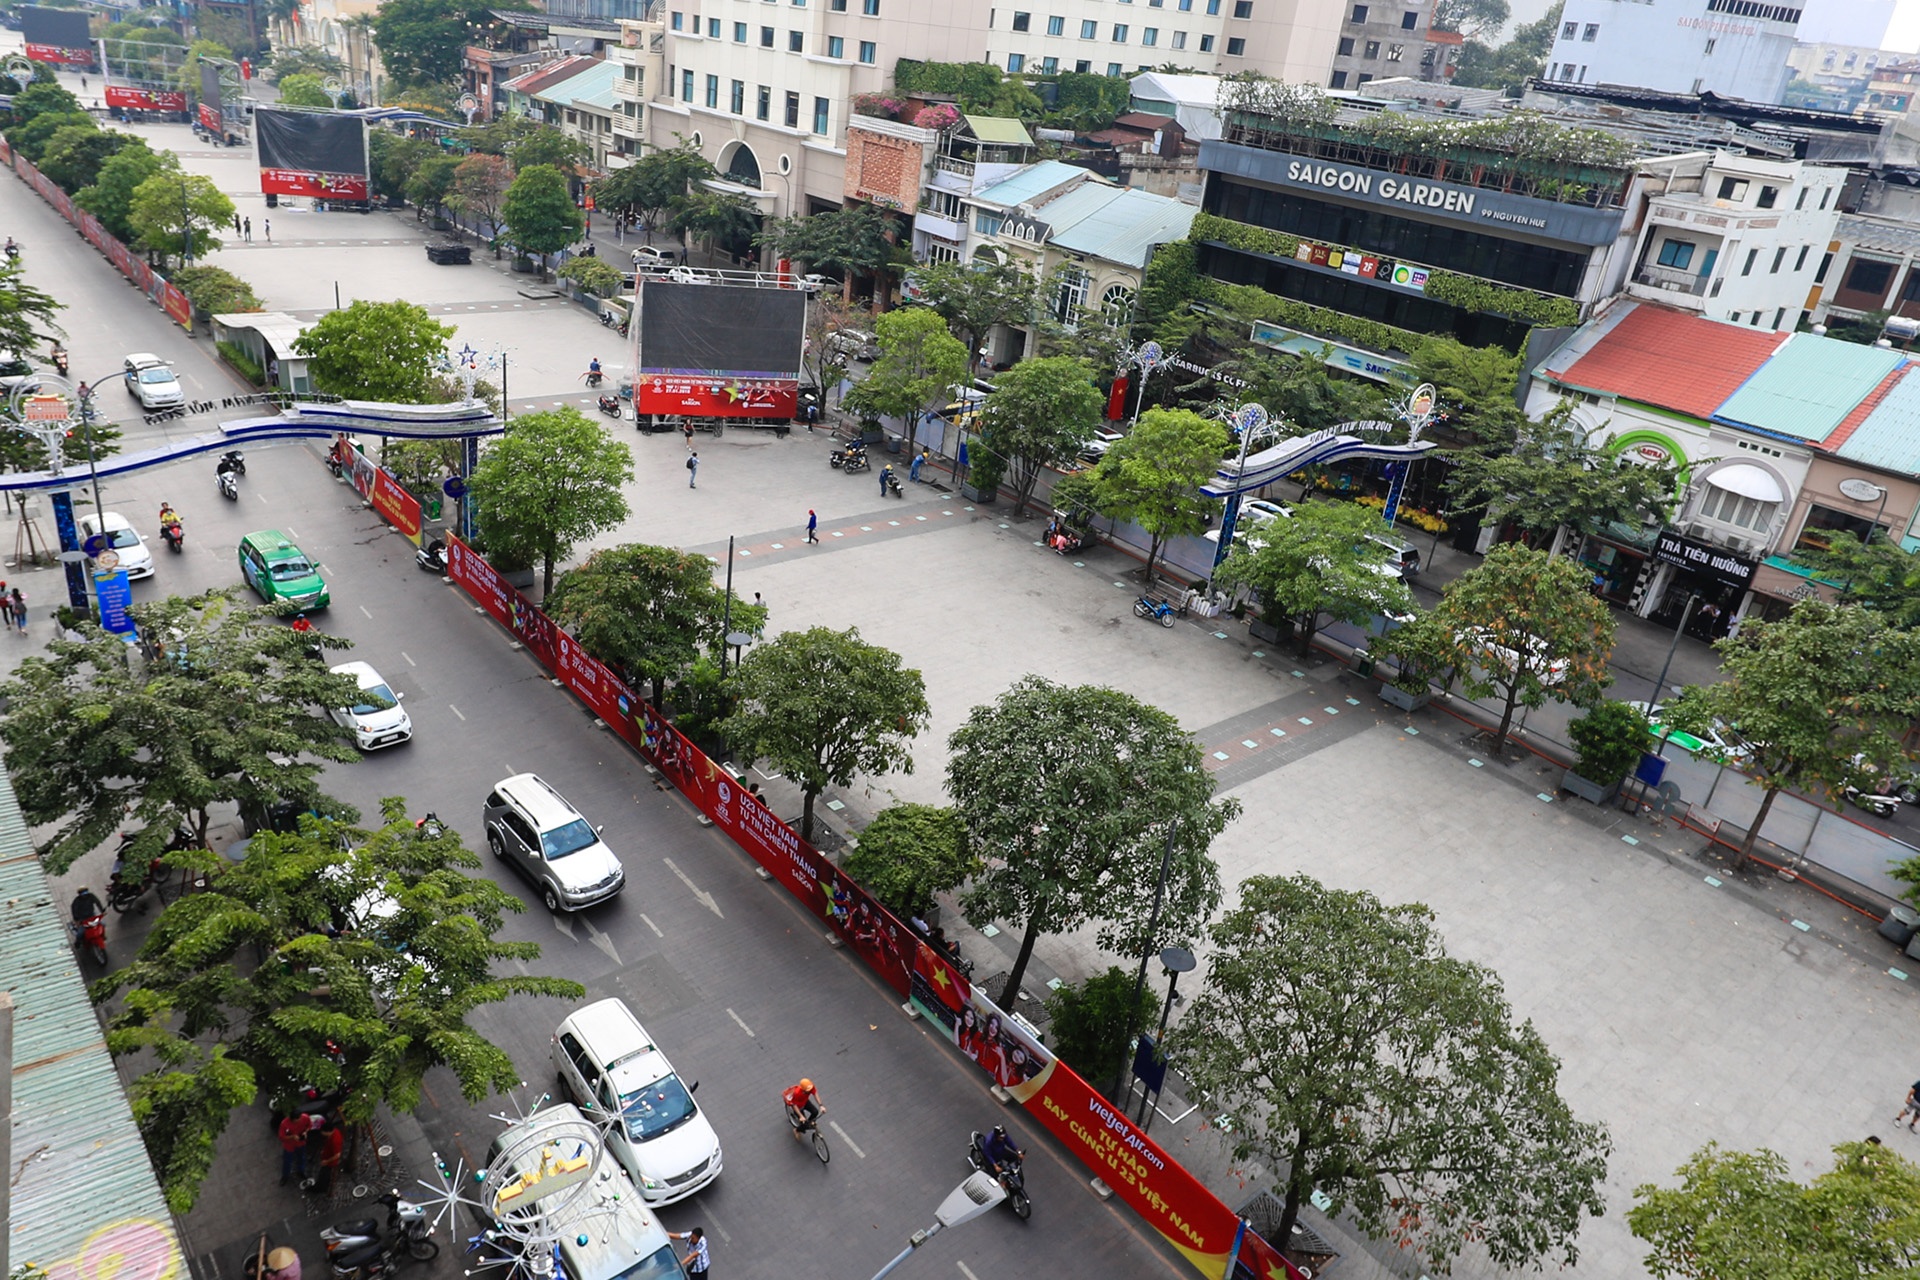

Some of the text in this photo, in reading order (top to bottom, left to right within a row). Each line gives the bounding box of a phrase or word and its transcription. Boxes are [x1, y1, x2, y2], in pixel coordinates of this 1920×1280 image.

[1287, 161, 1546, 229] SAIGON GARDEN 99 NGUYEN HUE
[1363, 262, 1374, 272] 2F
[1310, 420, 1393, 444] HAPPY NEW YEAR 2018
[1660, 538, 1681, 554] TRÀ
[1684, 546, 1710, 564] TIÊN
[740, 793, 756, 813] U23
[778, 826, 799, 851] NAM
[750, 815, 763, 833] TIN
[1043, 1096, 1069, 1122] BAY
[1107, 1157, 1118, 1170] U
[1119, 1166, 1136, 1186] 23
[1139, 1182, 1170, 1214] VIỆT
[1169, 1212, 1205, 1248] NAM
[1099, 1128, 1148, 1178] TỰ HÀO
